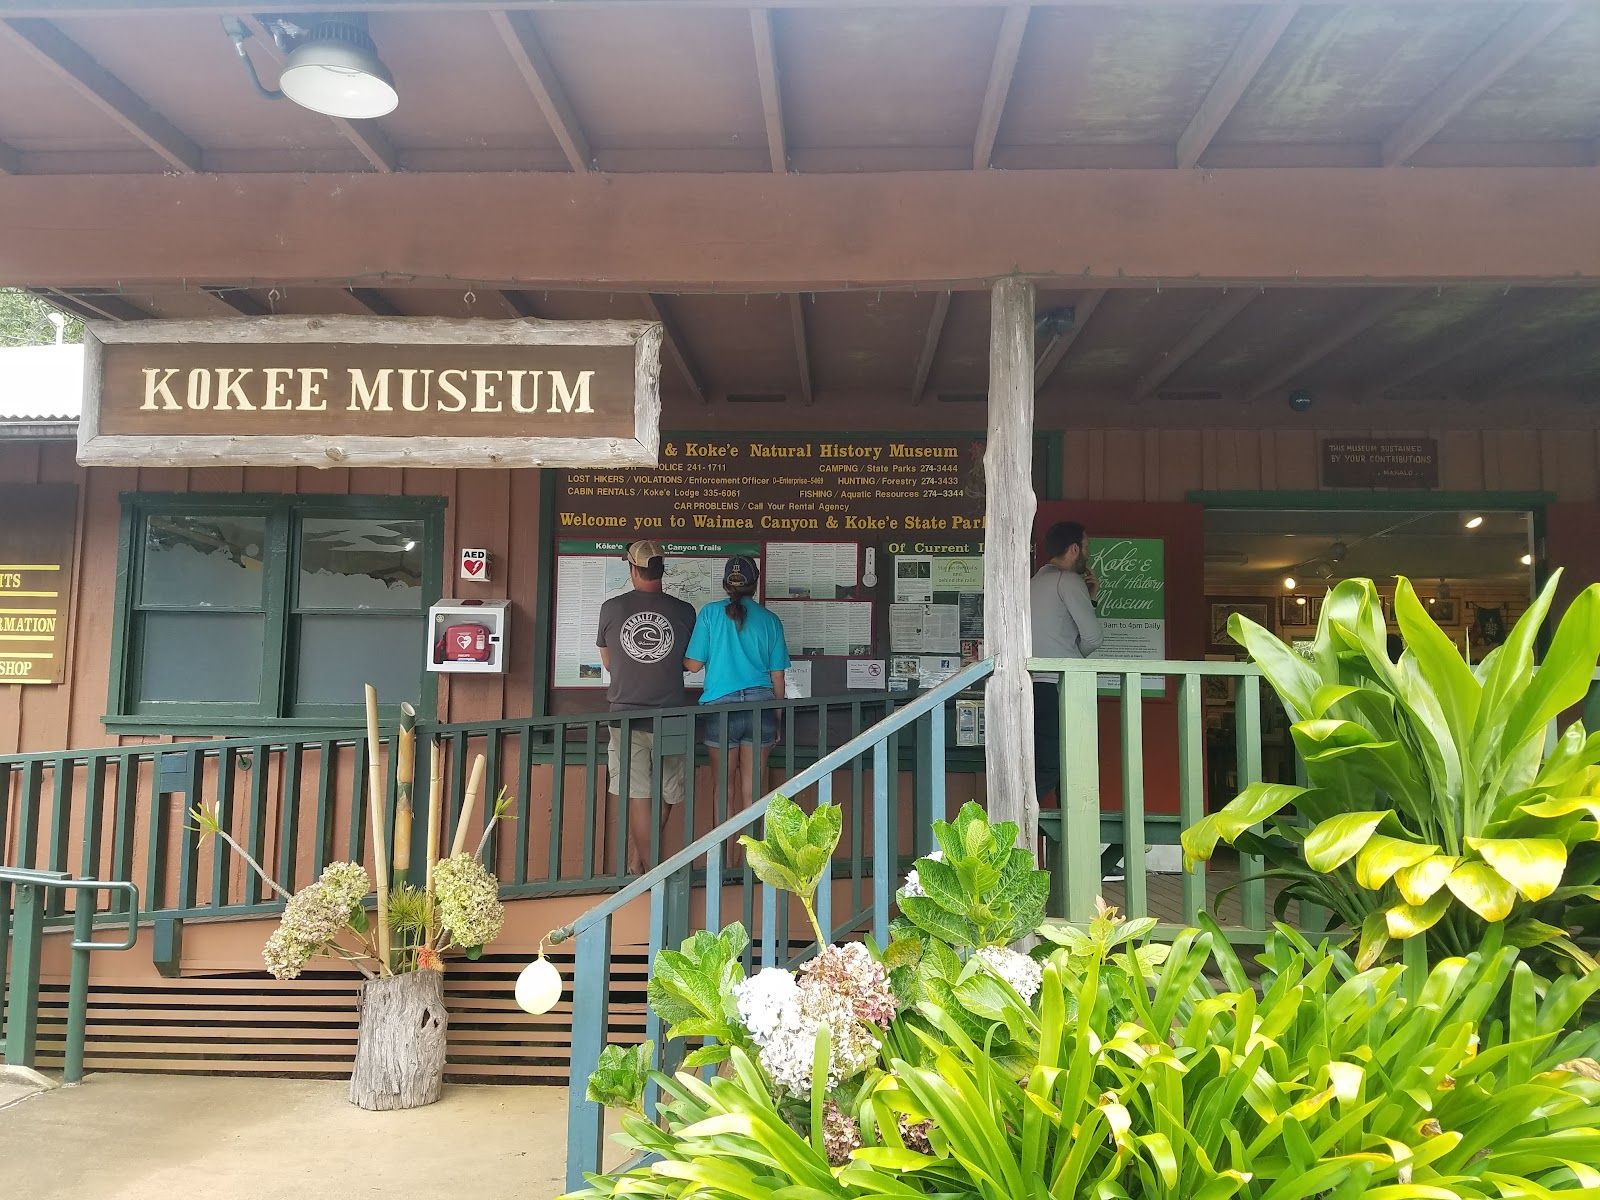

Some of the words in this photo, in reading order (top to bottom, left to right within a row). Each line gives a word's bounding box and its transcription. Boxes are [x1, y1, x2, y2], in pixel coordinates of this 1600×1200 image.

[139, 367, 328, 410] KOKEE
[346, 368, 596, 413] MUSEUM
[664, 442, 678, 457] &
[685, 442, 739, 457] Koke'e
[750, 443, 811, 458] Natural
[820, 443, 882, 460] History
[889, 443, 959, 458] Museum
[1331, 455, 1341, 463] BY
[1344, 455, 1366, 463] YOUR
[1369, 455, 1432, 464] CONTRIBUTIONS
[819, 464, 858, 473] CAMPING
[866, 464, 889, 473] State
[892, 464, 917, 473] Parks
[920, 464, 958, 473] 274-3444
[568, 475, 590, 484] LOST
[594, 475, 625, 484] HIKERS
[633, 475, 683, 484] VIOLATIONS
[689, 476, 740, 485] Enforcement
[742, 477, 770, 485] Officer
[838, 477, 875, 485] HUNTING
[882, 477, 917, 487] Forestry
[921, 477, 959, 485] 274-3433
[567, 487, 594, 496] CABIN
[597, 488, 636, 496] RENTALS
[674, 489, 700, 499] Lodge
[703, 489, 741, 497] 335-6061
[799, 490, 833, 498] FISHING
[840, 490, 872, 500] Aquatic
[875, 490, 919, 498] Resources
[674, 502, 692, 510] CAR
[694, 502, 740, 511] PROBLEMS
[748, 502, 764, 511] Call
[767, 503, 785, 511] Your
[789, 503, 815, 511] Rental
[819, 503, 849, 513] Agency
[560, 512, 627, 527] Welcome
[634, 516, 663, 530] you
[670, 514, 686, 528] to
[693, 514, 754, 529] Waimea
[760, 515, 818, 532] Canyon
[825, 515, 839, 529] &
[845, 515, 898, 530] Koke'e
[904, 515, 947, 530] State
[667, 543, 697, 552] Canyon
[699, 543, 722, 551] Trails
[888, 543, 905, 554] Of
[914, 543, 969, 554] Current
[463, 551, 485, 559] AED
[1123, 574, 1165, 591] History
[1095, 589, 1154, 617] Museum
[654, 616, 671, 630] SURF
[1103, 621, 1118, 629] 9am
[1128, 622, 1143, 630] 4pm
[1144, 622, 1161, 630] Daily
